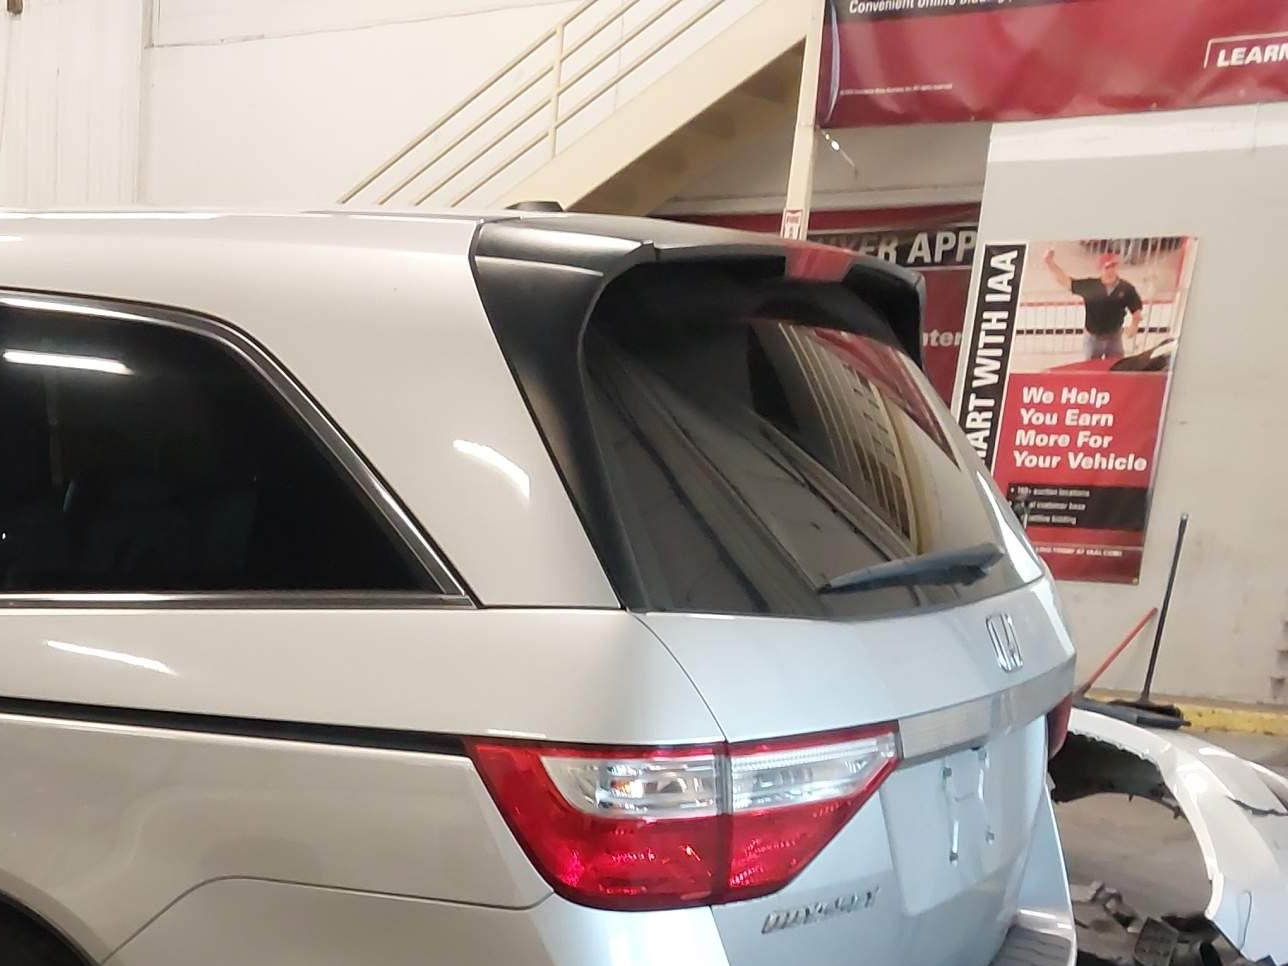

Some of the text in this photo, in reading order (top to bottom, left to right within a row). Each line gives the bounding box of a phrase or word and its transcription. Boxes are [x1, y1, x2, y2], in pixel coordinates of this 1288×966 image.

[907, 230, 977, 264] APP
[965, 249, 1019, 466] ART WITH IAA
[1022, 386, 1111, 408] We Help
[1020, 408, 1114, 427] You Earn
[1015, 429, 1114, 448] More For
[1013, 450, 1148, 471] Your Vehicle
